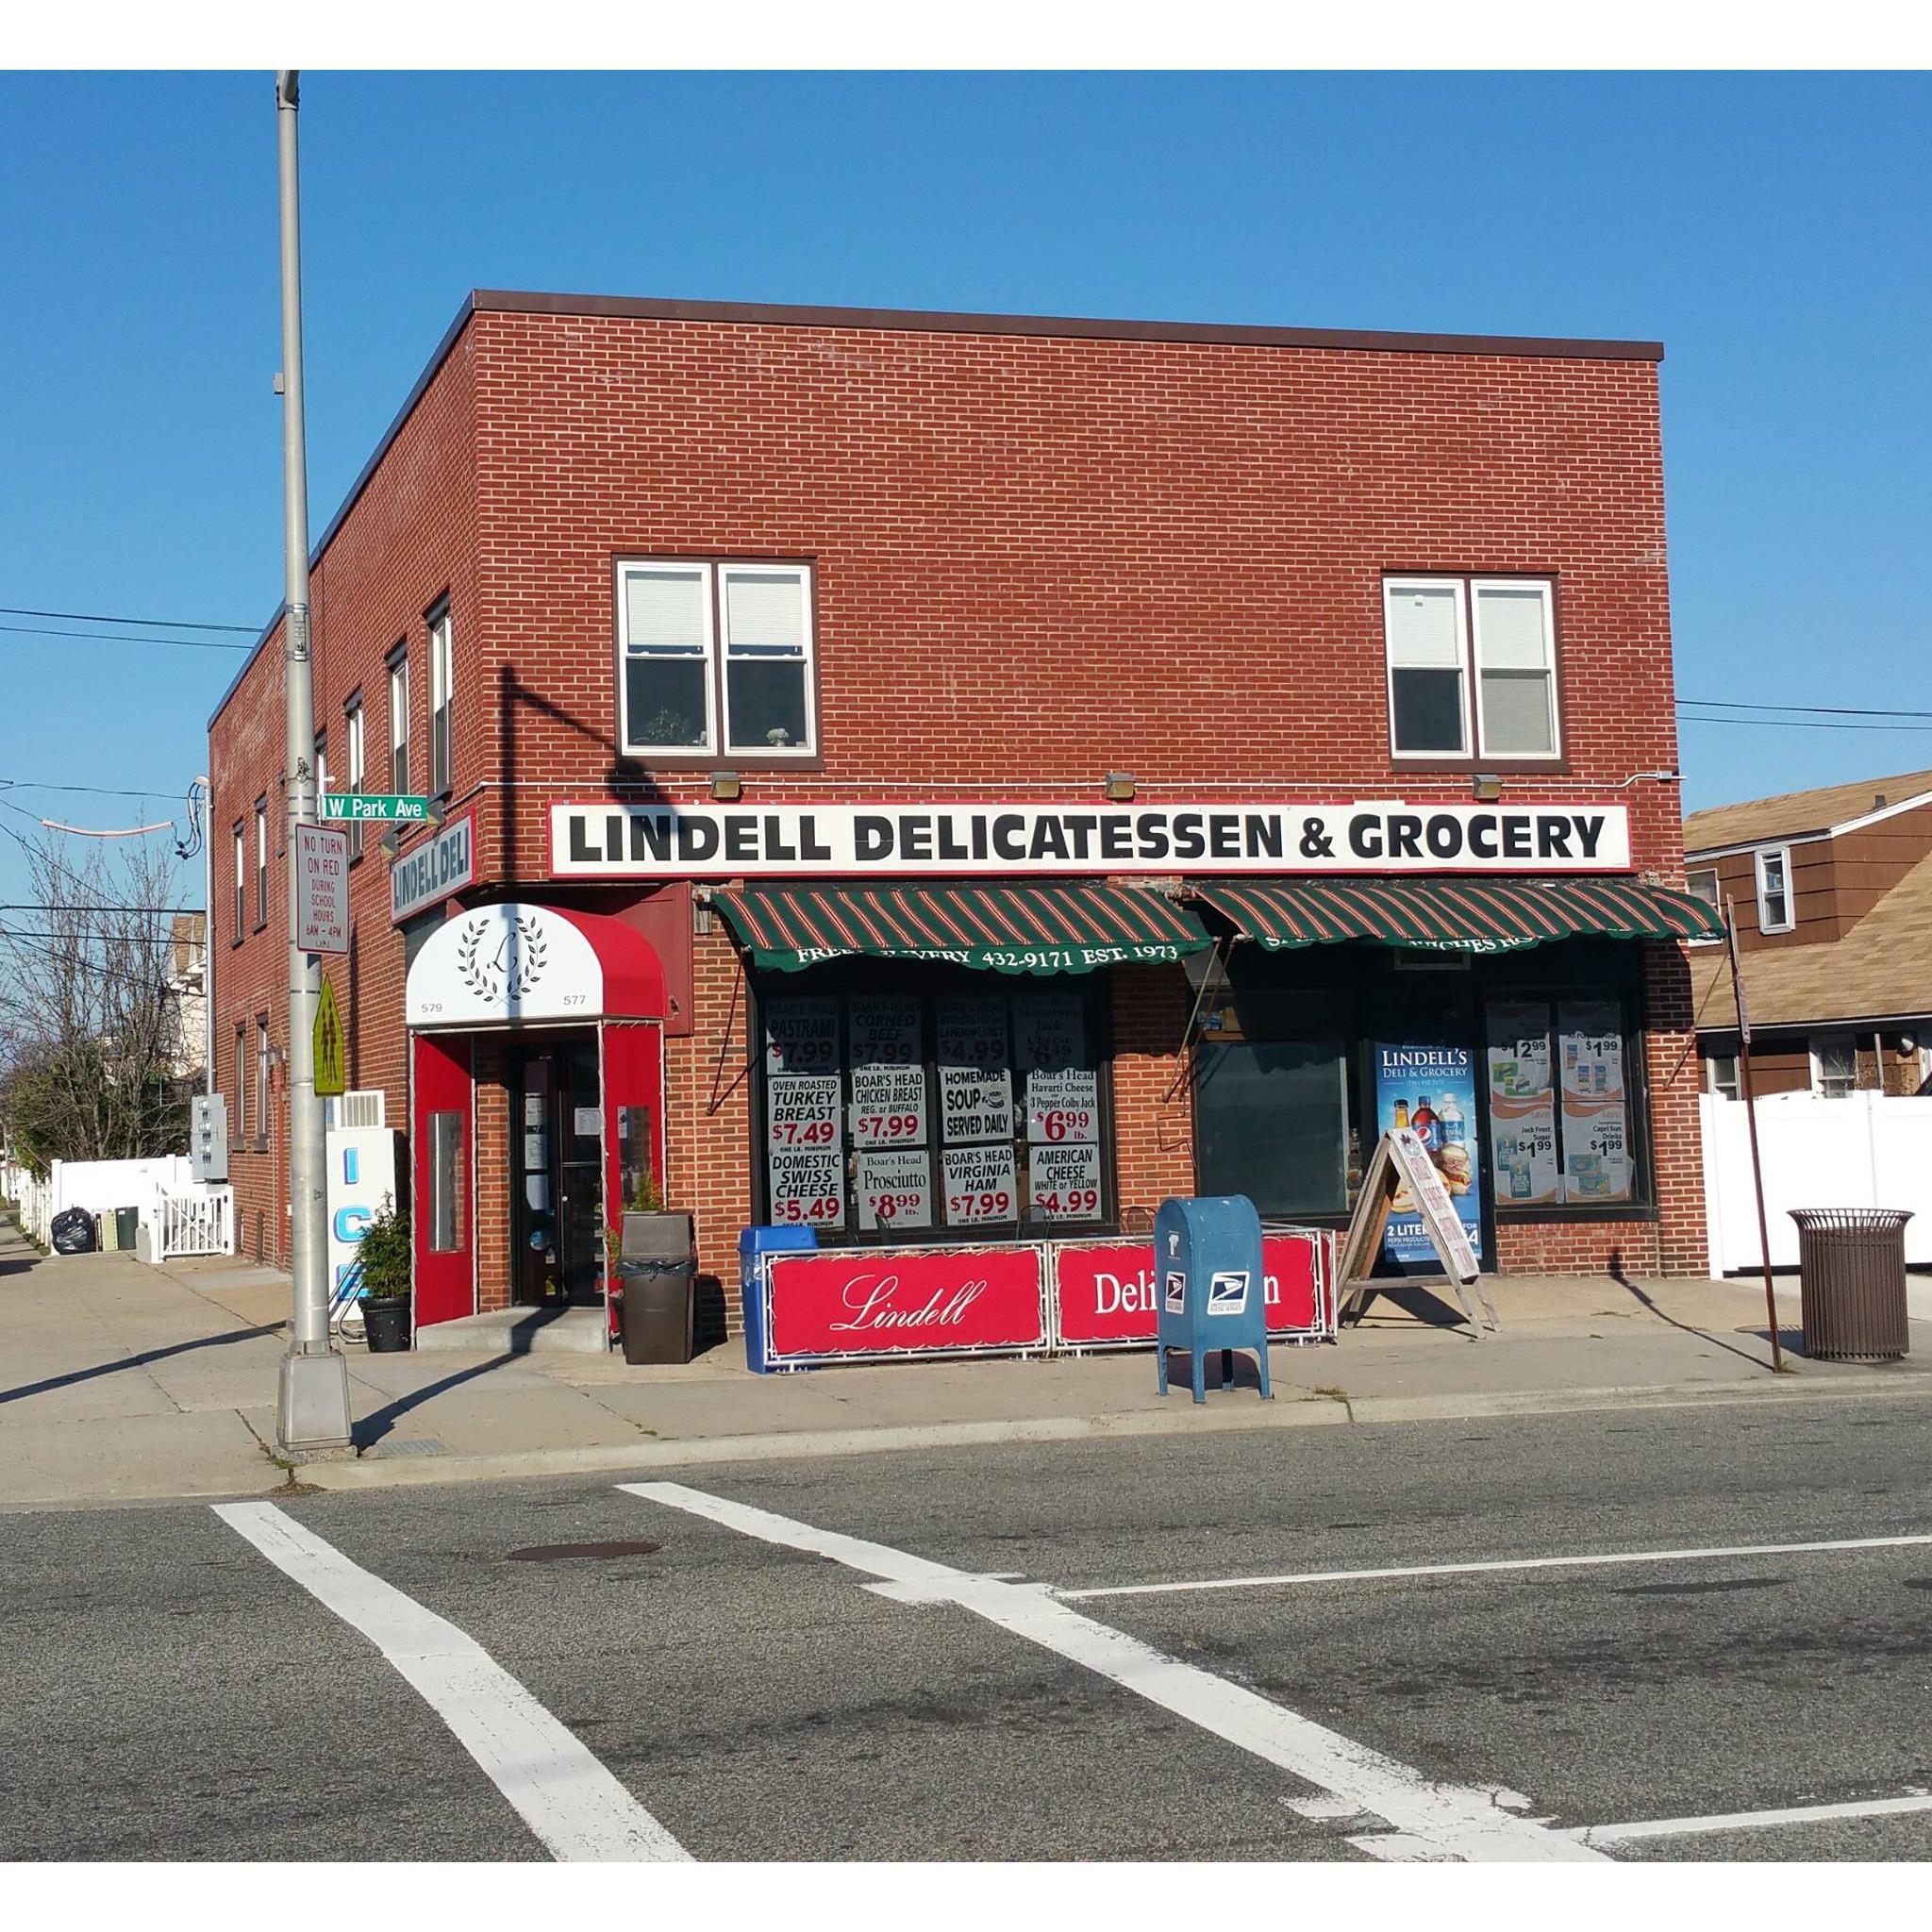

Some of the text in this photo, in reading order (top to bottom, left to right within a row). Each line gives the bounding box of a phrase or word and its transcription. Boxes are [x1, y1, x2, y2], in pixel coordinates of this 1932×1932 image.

[330, 798, 423, 817] W Park Ave
[569, 813, 1606, 862] LINDELL DELICATESSEN & GROCERY
[304, 836, 342, 856] NO TURN
[308, 858, 340, 876] ON RED
[393, 826, 470, 911] LINDELL DELI
[311, 878, 335, 893] DURING
[310, 893, 336, 908] SCHOOL
[312, 908, 335, 923] HOURS
[328, 925, 341, 939] 4PM
[982, 952, 1074, 968] 432-9171
[1081, 947, 1128, 964] EST.
[1132, 945, 1178, 960] 1973
[421, 995, 587, 1013] 579 577
[771, 1018, 836, 1039] PASTRAMI
[856, 1014, 915, 1027] CORNED
[868, 1028, 905, 1041] BEEF
[772, 1041, 833, 1063] $7.99
[852, 1042, 914, 1064] $7.99
[1382, 1048, 1468, 1067] LINDELL'S
[945, 1070, 1007, 1085] HOMEMADE
[1066, 1069, 1094, 1081] Head
[1408, 1067, 1419, 1077] &
[773, 1079, 837, 1091] OVEN ROASTED
[855, 1074, 923, 1088] BOAR'S HEAD
[1031, 1083, 1094, 1092] Havarti Cheese
[774, 1091, 836, 1106] TURKEY
[856, 1087, 923, 1105] CHICKEN BREAST
[946, 1089, 981, 1111] SOUP
[1030, 1096, 1096, 1111] 3 Pepper Colby Jack
[774, 1107, 836, 1122] BREAST
[861, 1103, 919, 1114] REG. or BUFFALO
[773, 1122, 835, 1145] $7.49
[858, 1114, 919, 1138] $7.99
[946, 1114, 1008, 1137] SERVED DAILY
[1074, 1130, 1088, 1140] lb.
[773, 1154, 841, 1170] DOMESTIC
[867, 1155, 922, 1167] Boar's Head
[945, 1149, 1012, 1166] BOAR'S HEAD
[1037, 1149, 1093, 1165] AMERICAN
[780, 1169, 833, 1185] SWISS
[949, 1163, 1011, 1179] VIRGINIA
[1045, 1165, 1085, 1180] CHEESE
[863, 1169, 926, 1191] Prosciutto
[965, 1178, 997, 1192] HAM
[1034, 1178, 1098, 1191] WHITE or YELLOW
[775, 1183, 839, 1198] CHEESE
[774, 1197, 840, 1222] $5.49
[950, 1191, 1010, 1216] $7.99
[1035, 1190, 1098, 1213] $4.99
[1387, 1225, 1394, 1237] 2
[829, 1274, 988, 1331] Lindell
